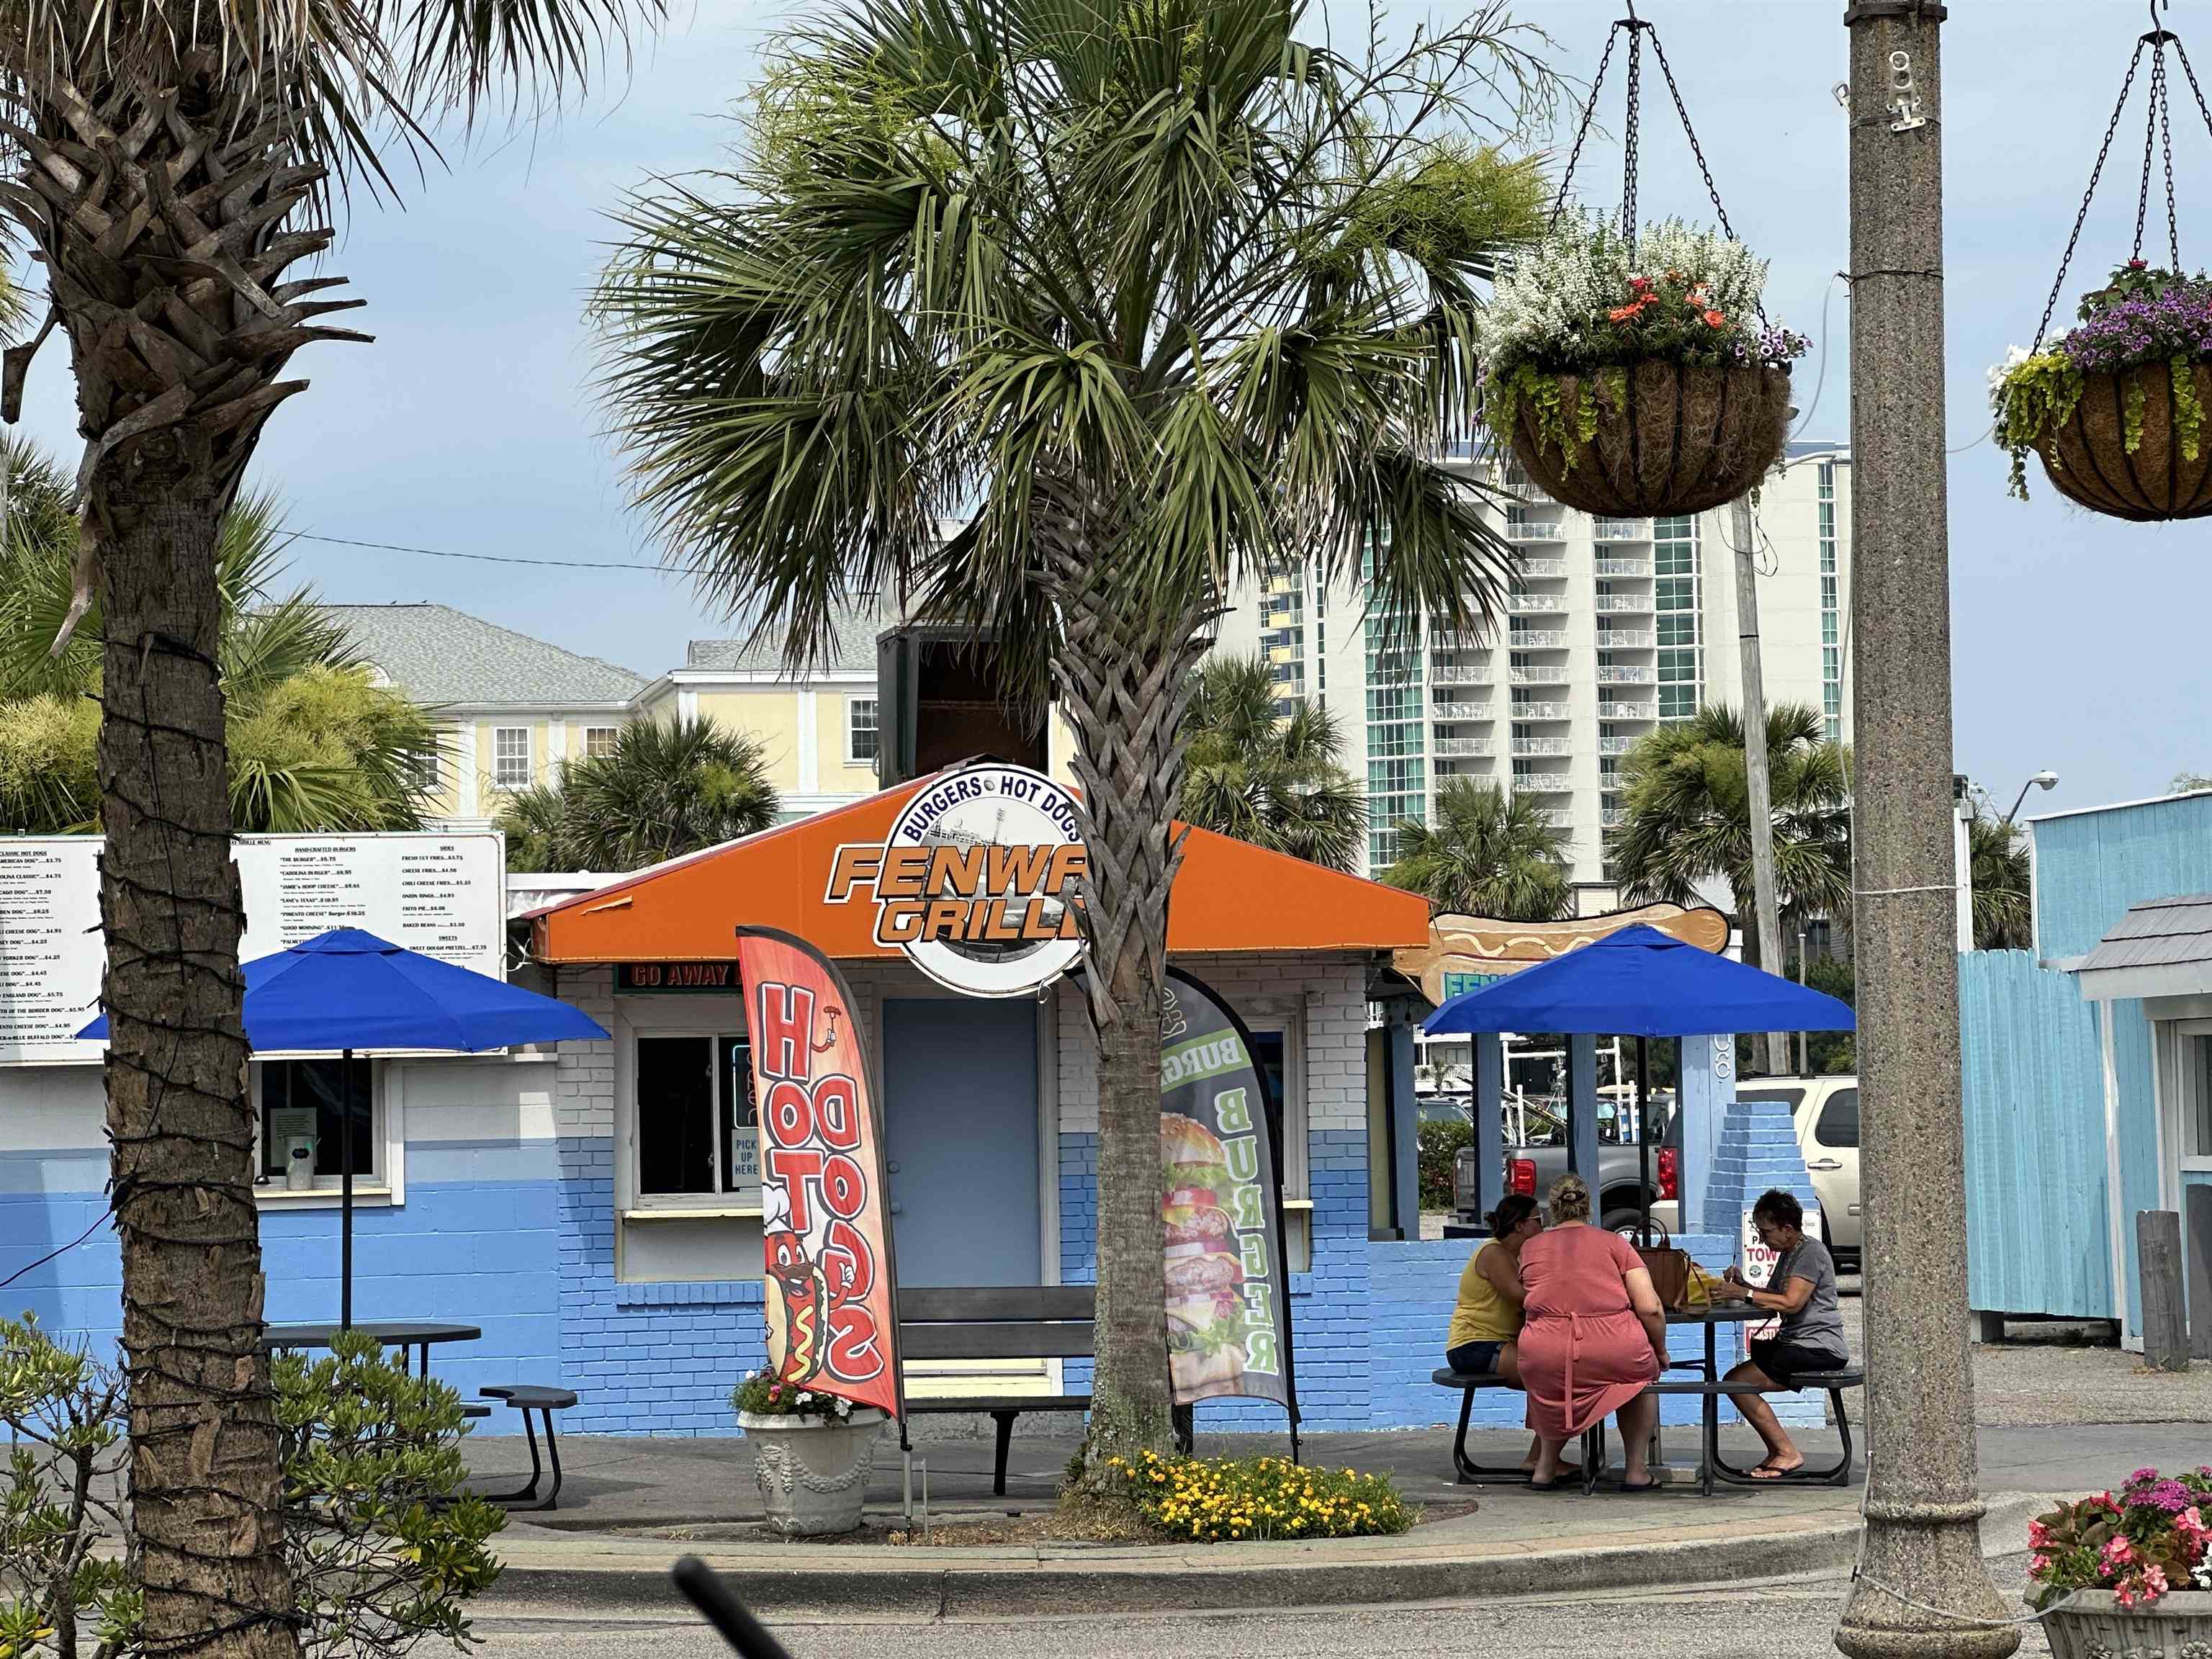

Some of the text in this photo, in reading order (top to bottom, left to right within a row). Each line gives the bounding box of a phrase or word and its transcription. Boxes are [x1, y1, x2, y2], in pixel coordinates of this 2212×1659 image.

[902, 775, 1080, 842] BURGERS HOT DOGS
[828, 845, 1086, 899] FENWA
[632, 964, 662, 986] GO
[667, 965, 729, 986] AWAY
[737, 1140, 757, 1150] PICK
[741, 1152, 752, 1161] UP
[735, 1164, 757, 1174] HERE
